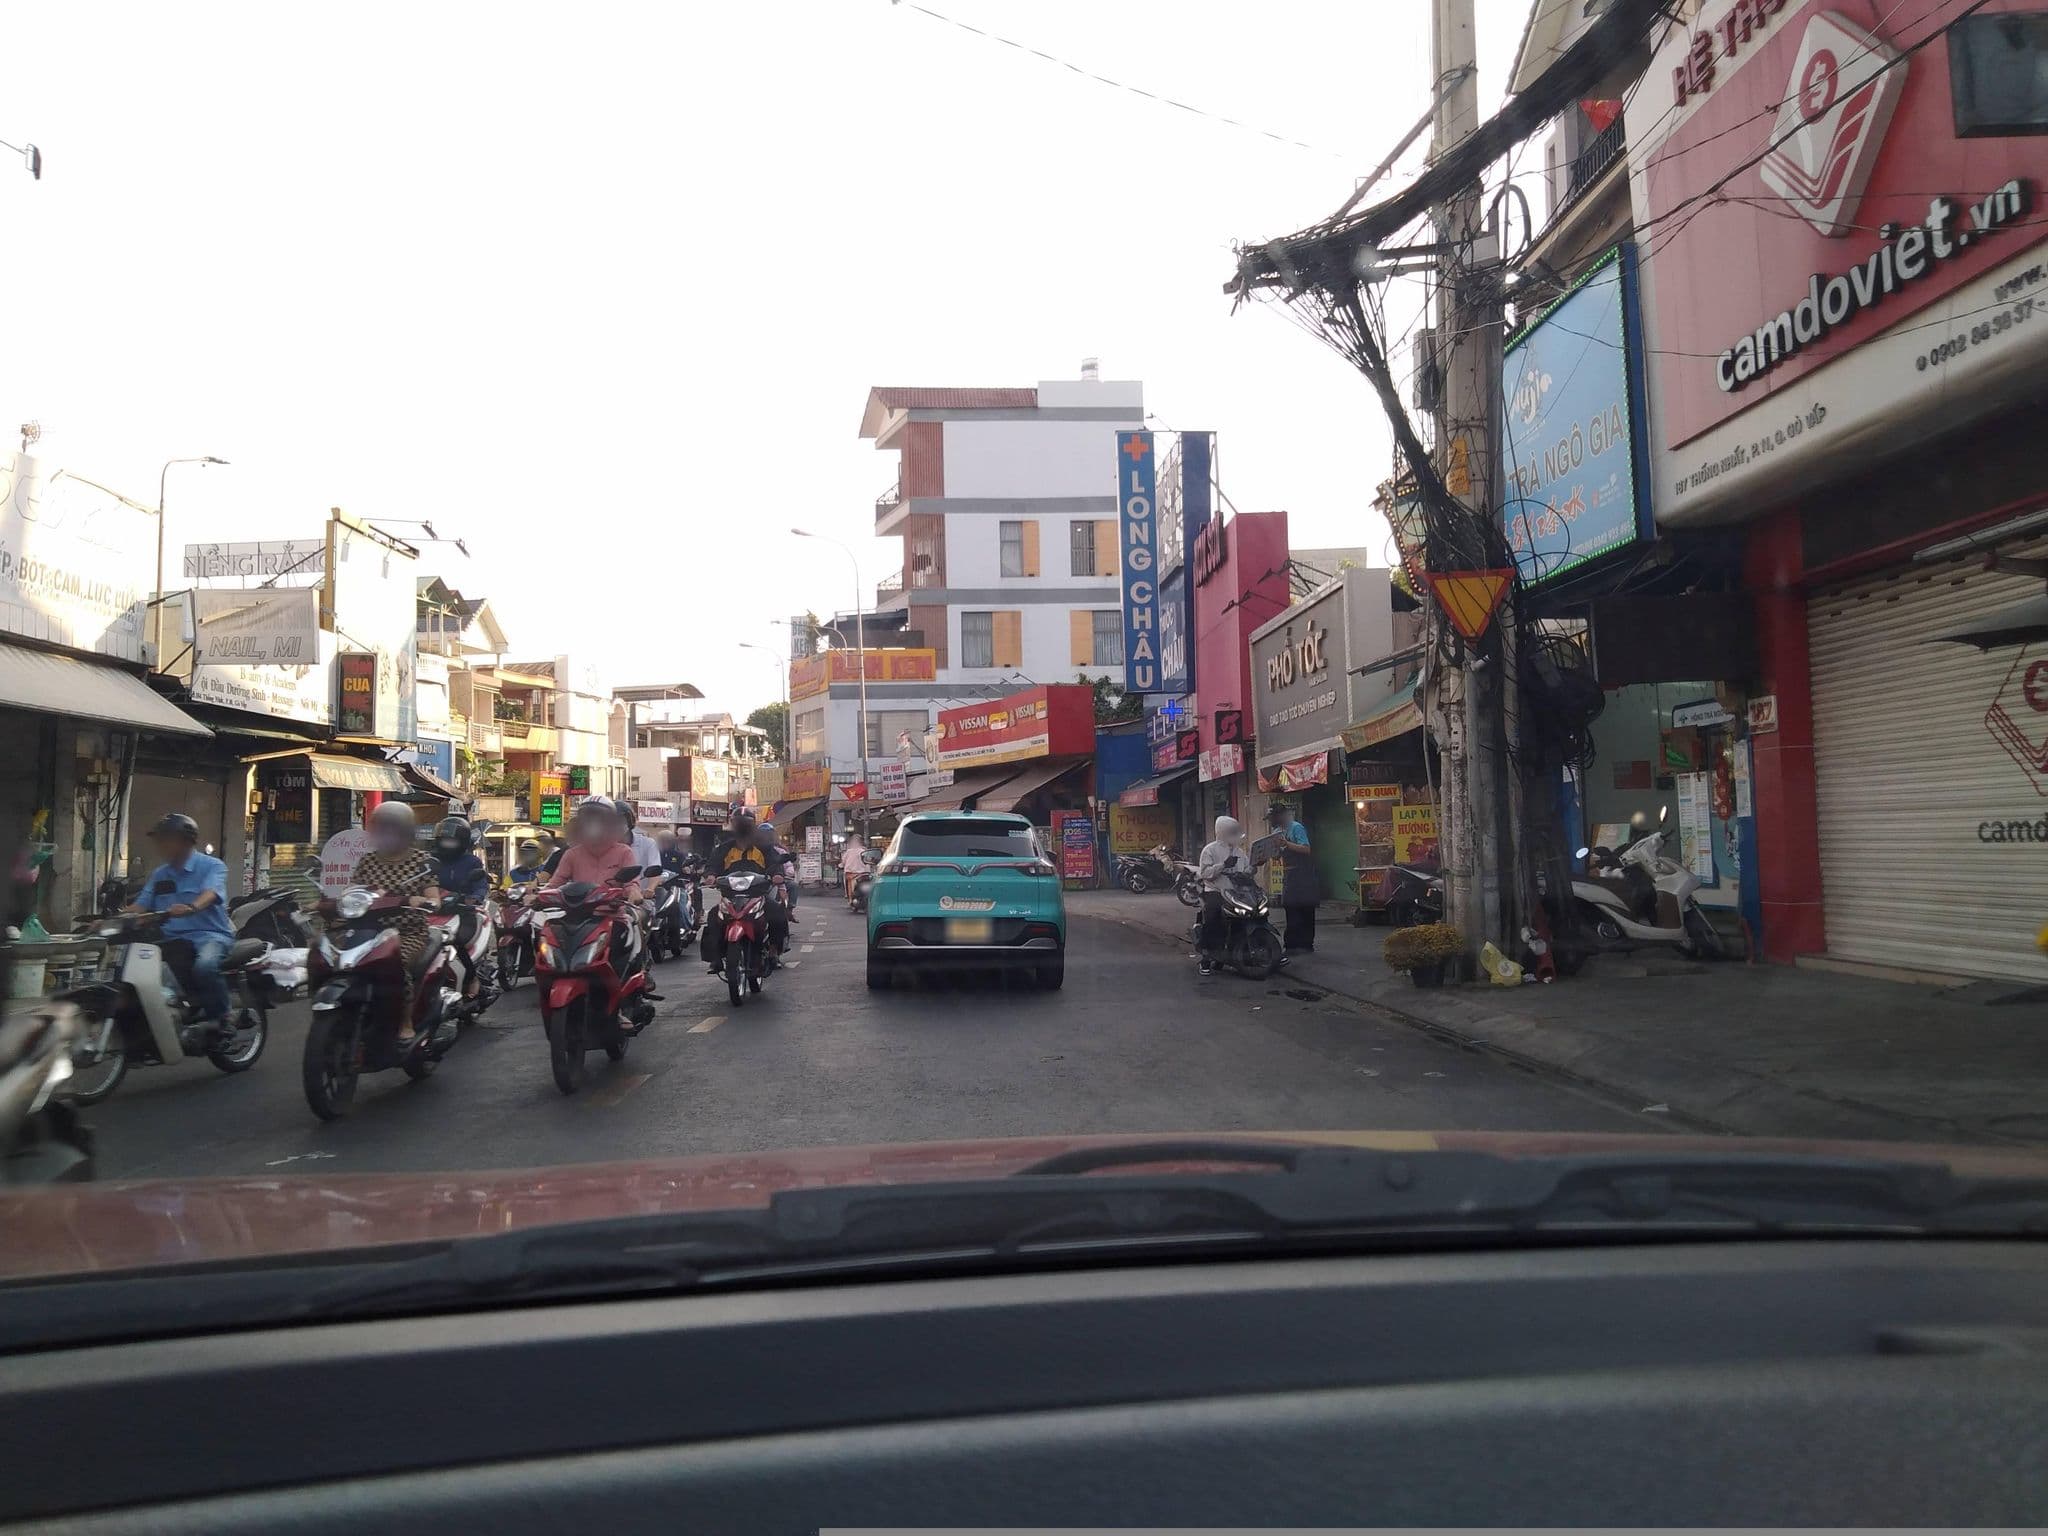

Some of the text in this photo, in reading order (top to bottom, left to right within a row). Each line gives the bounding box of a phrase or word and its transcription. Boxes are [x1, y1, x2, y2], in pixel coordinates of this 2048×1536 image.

[1672, 30, 1716, 107] HỆ
[1715, 178, 2025, 393] camdoviet.vn
[1508, 450, 1542, 505] TRÀ
[1544, 421, 1584, 486] NGÔ
[1588, 403, 1625, 457] GIA
[1126, 470, 1155, 689] LONG CHÂU
[208, 635, 302, 660] NAIL, MI
[1161, 632, 1185, 681] CHÂU
[252, 688, 266, 702] Sinh
[343, 677, 371, 692] CUA
[959, 715, 988, 731] VISSAN
[1015, 702, 1035, 720] VISSAN
[1352, 786, 1397, 797] HEO QUAY
